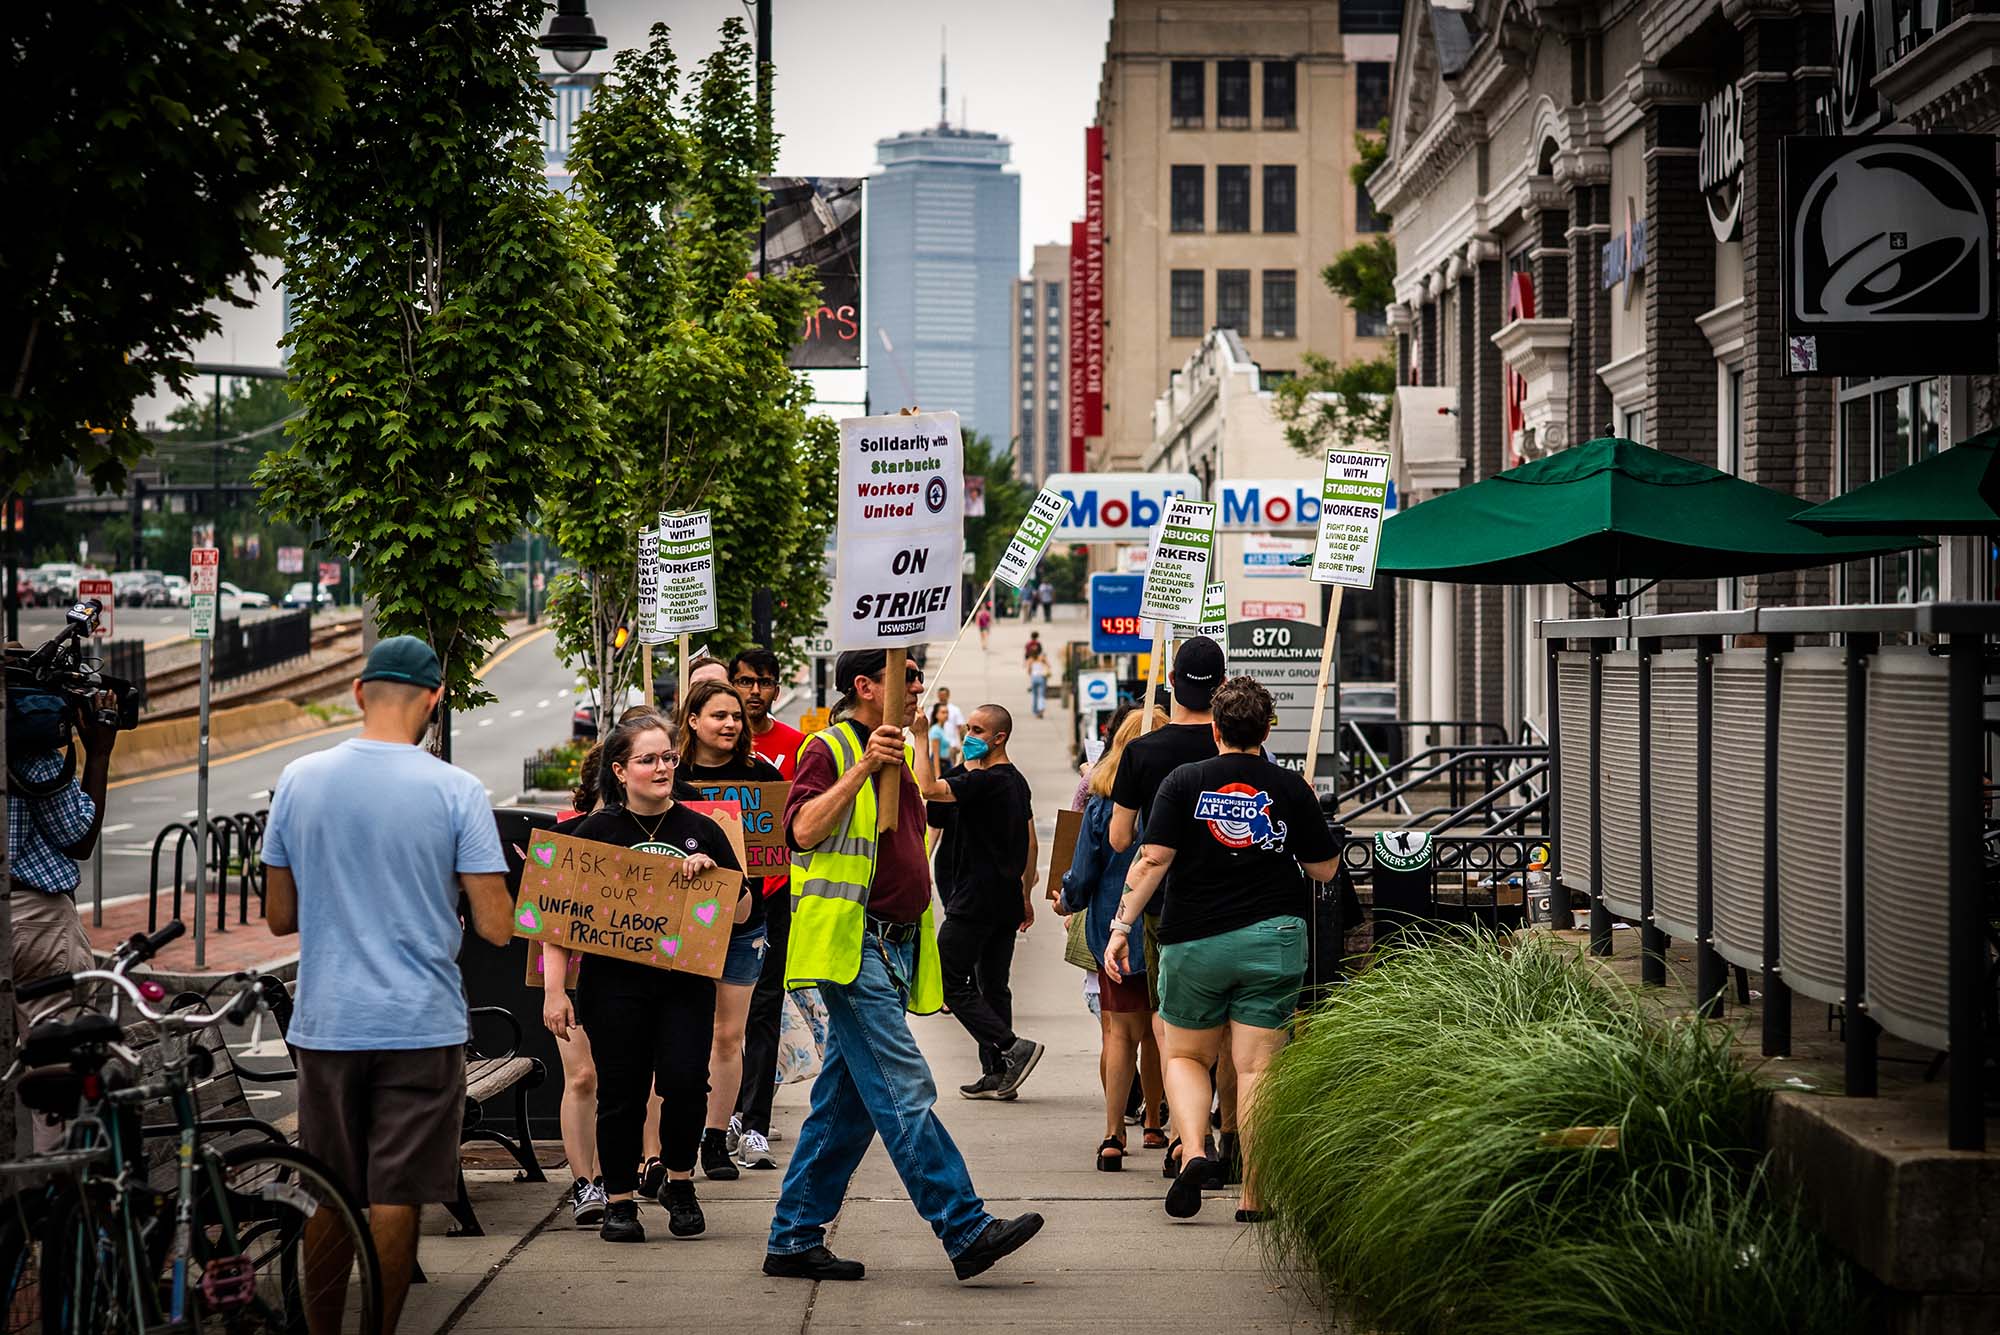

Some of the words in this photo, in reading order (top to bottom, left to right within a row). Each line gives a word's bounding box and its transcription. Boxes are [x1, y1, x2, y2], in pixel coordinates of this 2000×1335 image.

[1088, 171, 1102, 301] UNIVERSITY
[1072, 257, 1083, 365] UNIVERSITY
[1088, 309, 1102, 394] BOSTON
[1072, 369, 1083, 438] BOSTON
[860, 435, 930, 452] Solidarity
[932, 435, 948, 447] with
[871, 457, 941, 474] Starbucks
[1329, 454, 1388, 468] SOLIDARITY
[1343, 468, 1369, 479] WITH
[858, 482, 920, 497] Workers
[1325, 483, 1383, 498] STARBUCKS
[864, 502, 914, 519] United
[1060, 488, 1186, 528] Mob
[1323, 503, 1379, 519] WORKERS
[669, 528, 696, 540] WITH
[1326, 523, 1345, 532] FIGHT
[1345, 524, 1362, 533] FOR
[1362, 526, 1369, 534] A
[1325, 532, 1346, 541] LIVING
[1347, 534, 1369, 544] BASE
[1010, 541, 1027, 556] ALL
[1328, 542, 1348, 551] WAGE
[1349, 543, 1361, 552] OF
[892, 548, 929, 576] ON
[1156, 547, 1207, 563] RKERS
[1155, 561, 1183, 571] CLEAR
[1318, 561, 1344, 571] BEFORE
[1345, 564, 1366, 574] TIPS!
[663, 582, 704, 592] GRIEVANCE
[671, 575, 696, 585] CLEAR
[661, 589, 707, 600] PROCEDURES
[1149, 585, 1168, 594] AND
[1168, 586, 1182, 595] NO
[669, 599, 687, 608] AND
[687, 598, 699, 606] NO
[852, 585, 952, 620] STRIKE!
[1146, 600, 1180, 611] FIRINGS
[669, 613, 700, 623] FIRINGS
[880, 621, 925, 634] USW8751.org
[1252, 627, 1291, 646] 870
[1202, 797, 1258, 807] MASSACHUSETTS
[1200, 803, 1258, 819] AFL-CIO
[560, 847, 608, 878] ASK
[625, 863, 654, 882] ME
[668, 871, 728, 898] ABOUT
[600, 885, 638, 907] OUR
[1538, 897, 1550, 911] G
[538, 894, 595, 922] UNFAIR
[610, 909, 669, 935] LABOR
[569, 919, 654, 953] PRACTICES
